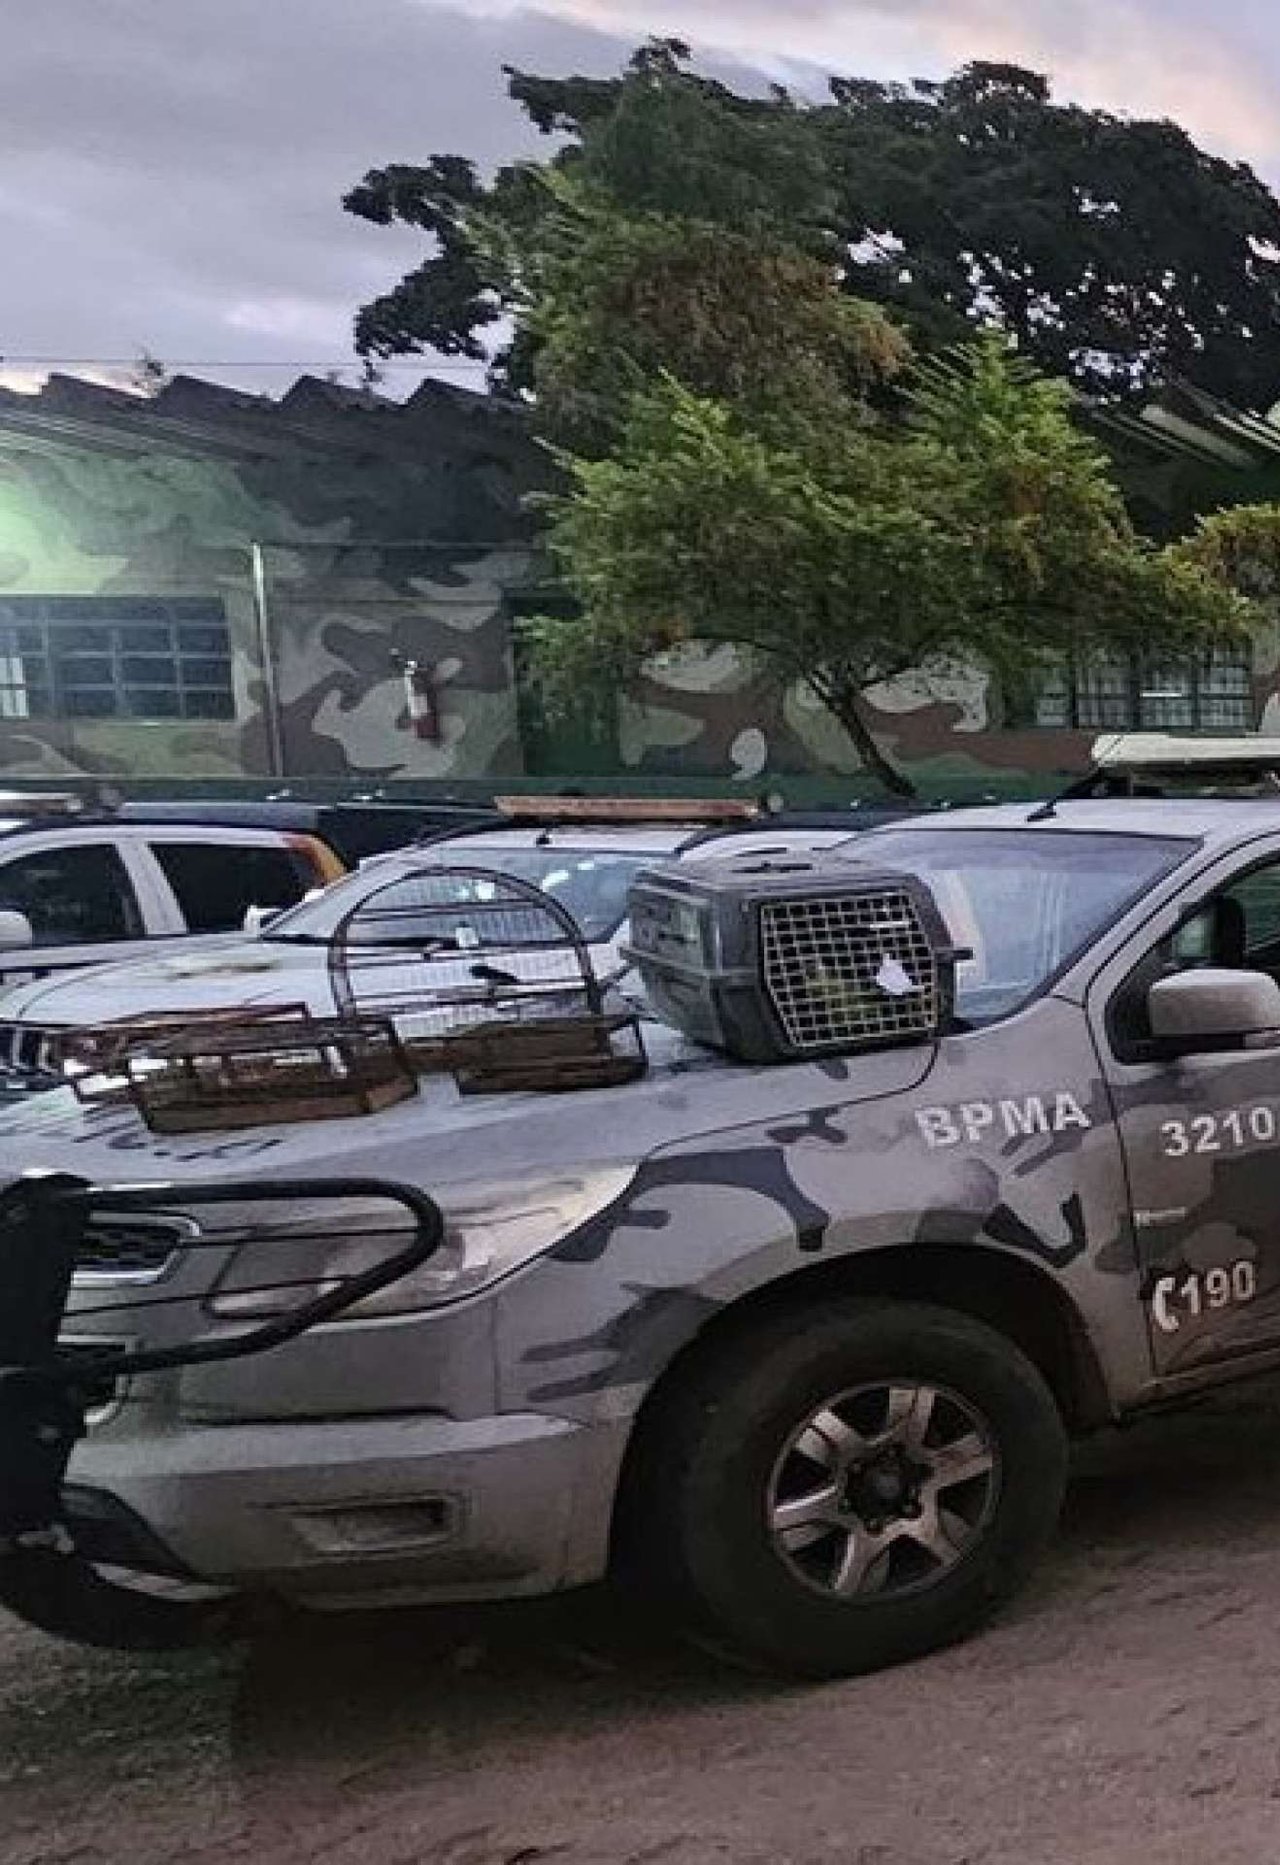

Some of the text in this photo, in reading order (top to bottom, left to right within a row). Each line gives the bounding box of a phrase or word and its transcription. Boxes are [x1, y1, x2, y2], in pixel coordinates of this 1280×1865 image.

[914, 1093, 1091, 1147] BPMA
[1161, 1106, 1275, 1157] 3210
[1180, 1260, 1256, 1316] 190
